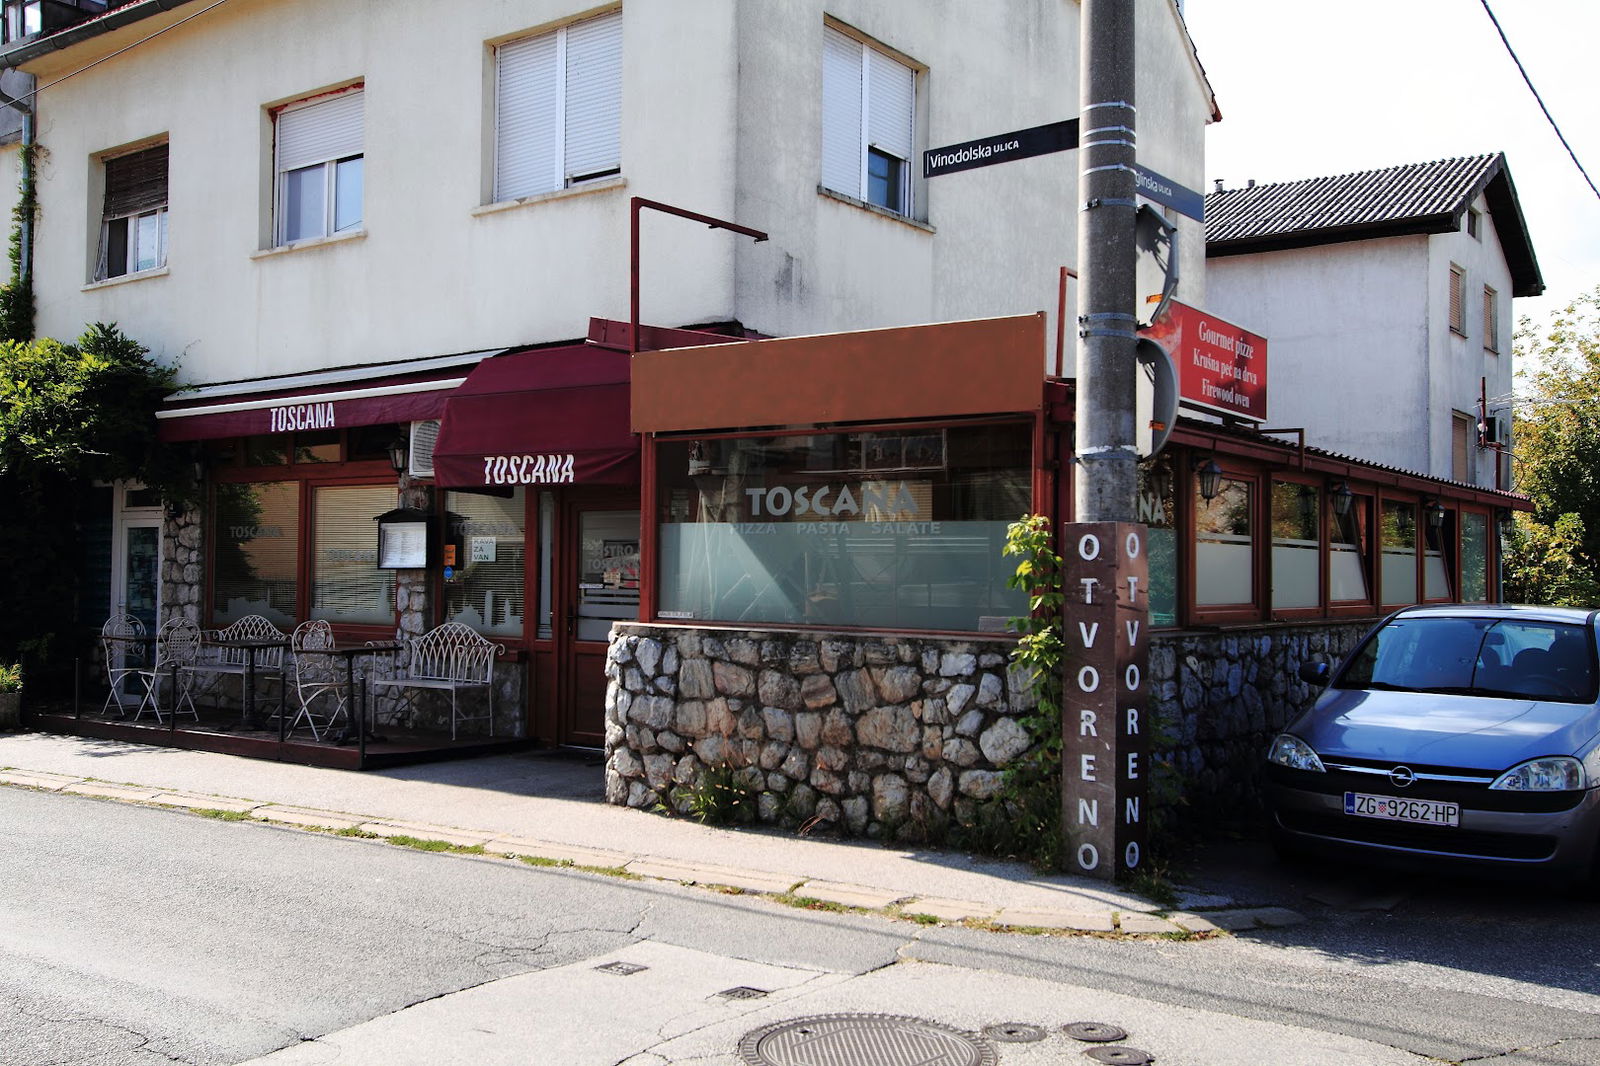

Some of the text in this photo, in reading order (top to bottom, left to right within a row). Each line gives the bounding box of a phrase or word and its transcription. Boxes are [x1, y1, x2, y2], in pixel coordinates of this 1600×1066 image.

[930, 140, 1020, 168] Vinodolska ULICA
[1135, 171, 1158, 193] glinska
[1198, 320, 1254, 360] Gourmet pizze
[1193, 347, 1257, 385] Krušna peć na drva
[1202, 378, 1250, 408] Firewood oven
[270, 402, 335, 432] TOSCANA
[484, 454, 575, 484] TOSCANA
[746, 484, 919, 516] TOSCANA
[797, 522, 850, 535] PASTA
[871, 522, 941, 535] SALATE
[1077, 533, 1100, 871] OTVORENO
[1125, 532, 1140, 869] OTVORENO
[1356, 796, 1376, 814] ZG
